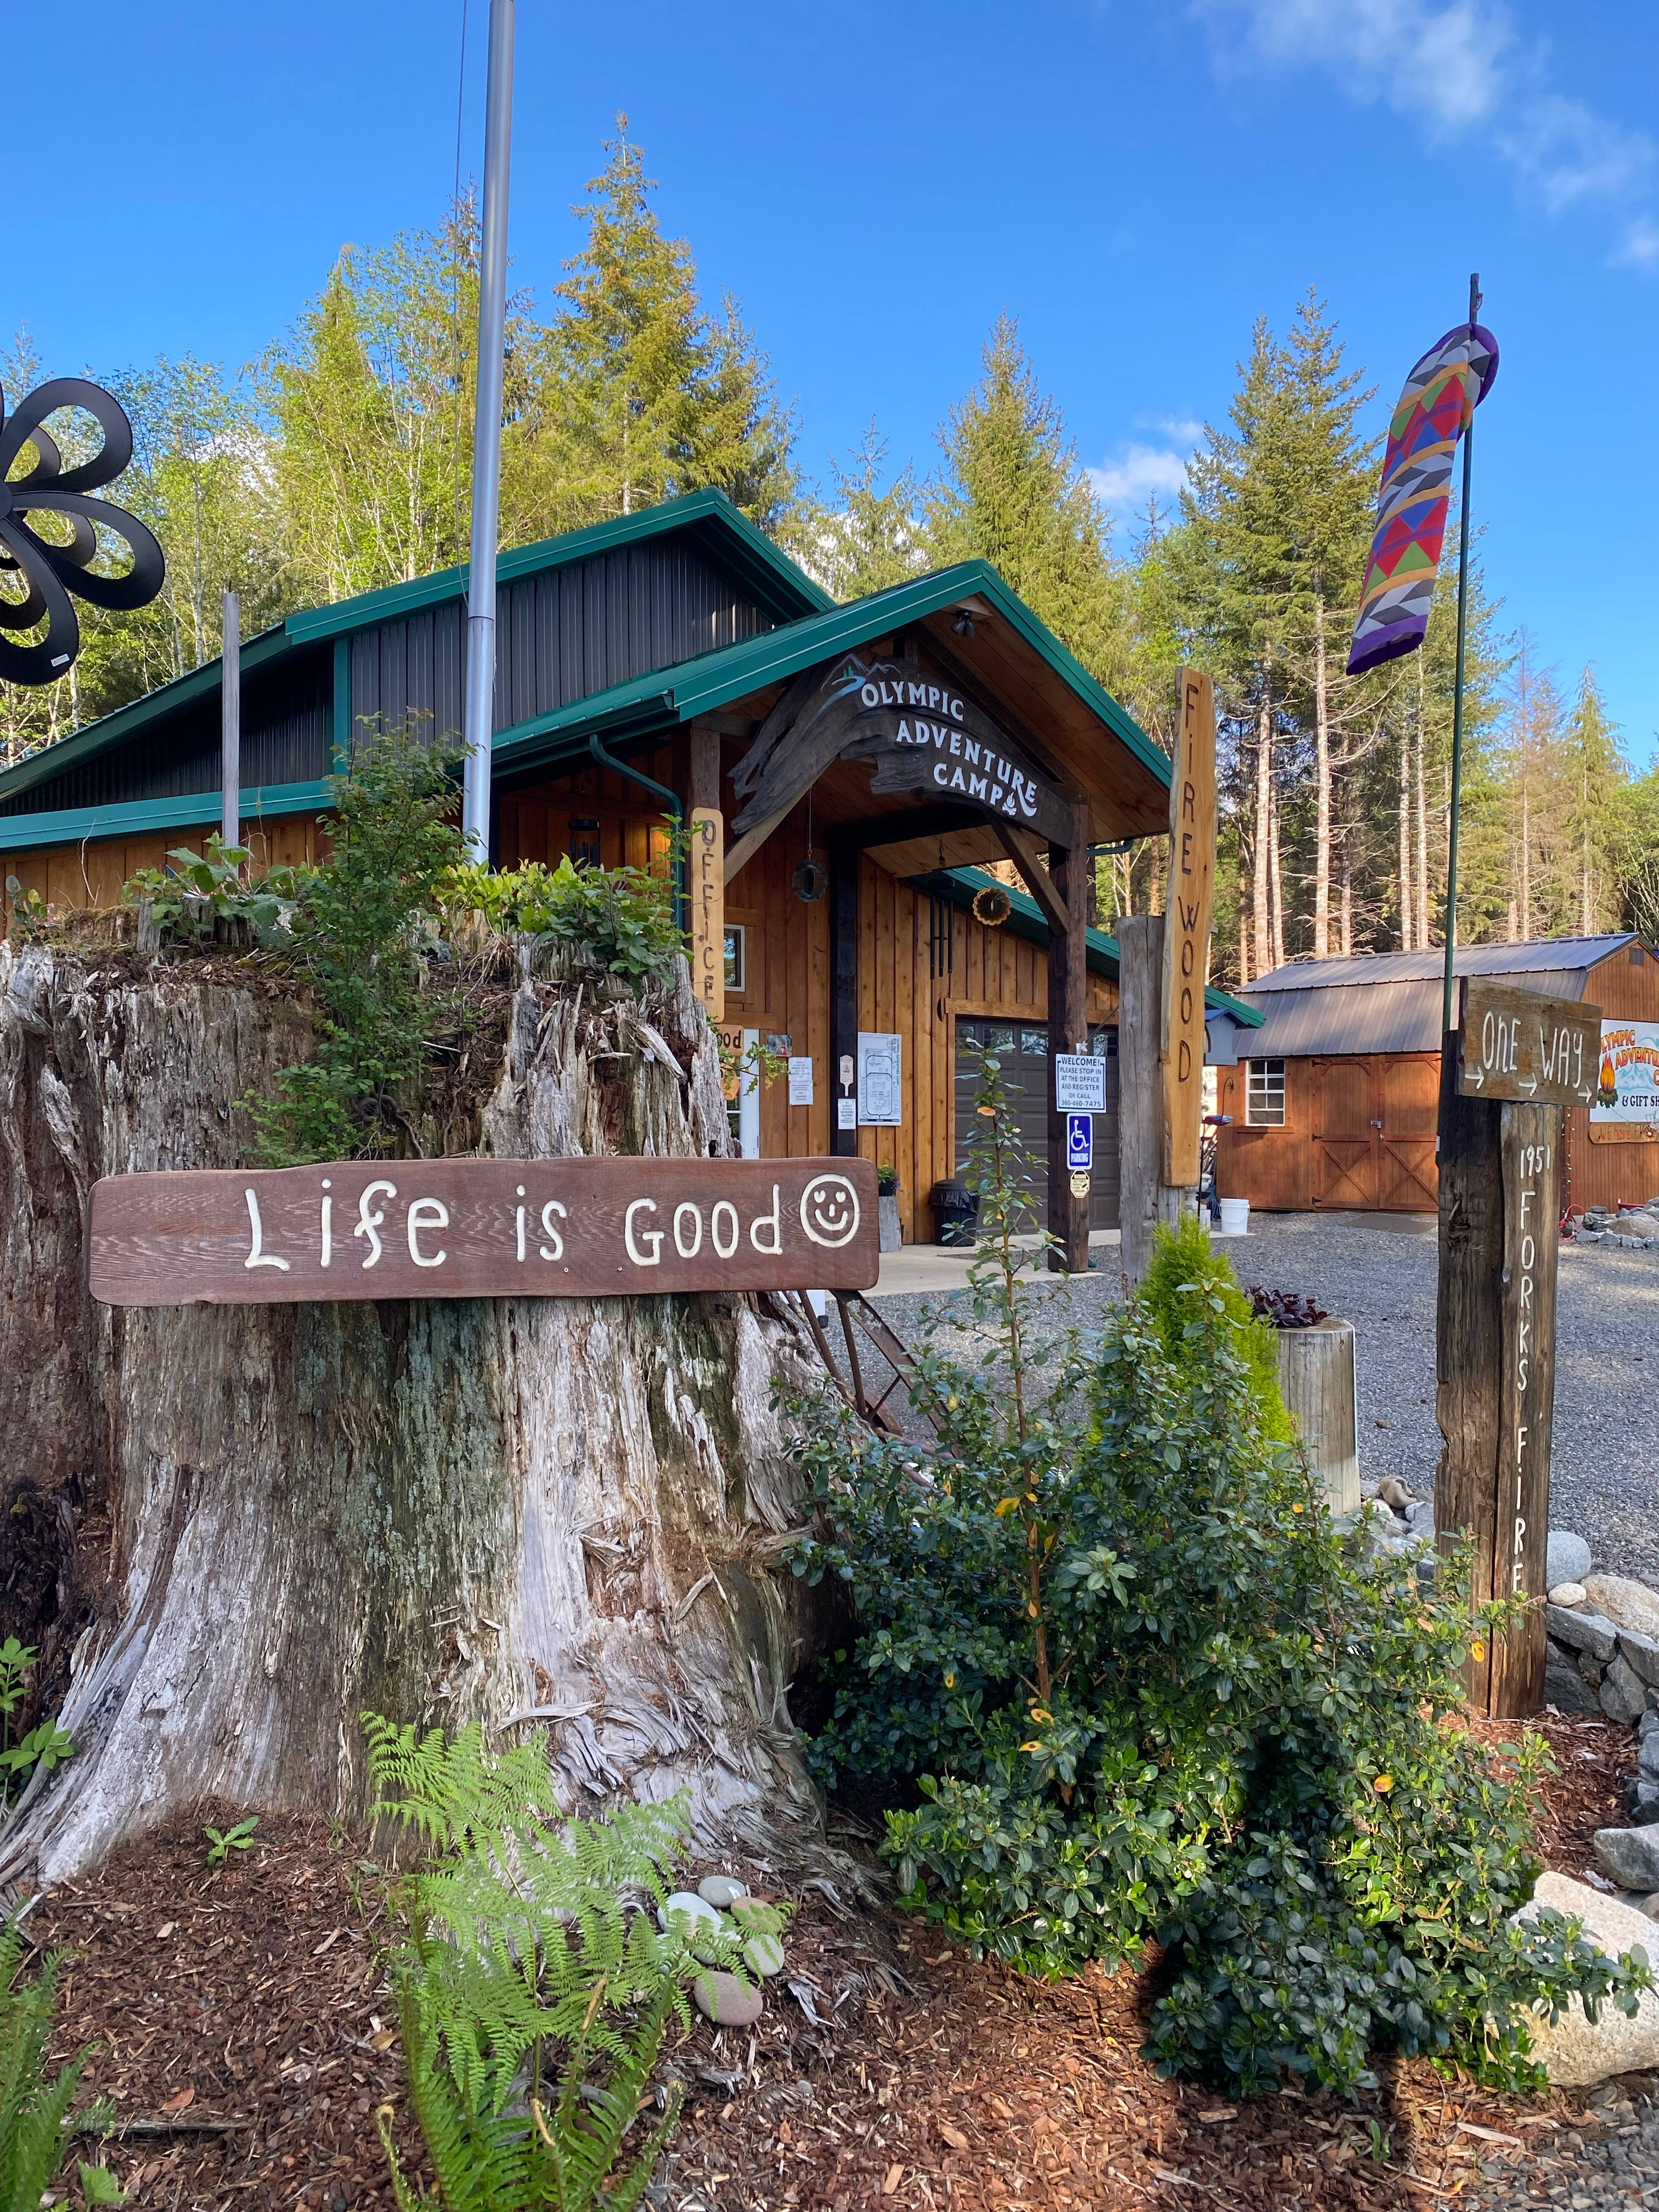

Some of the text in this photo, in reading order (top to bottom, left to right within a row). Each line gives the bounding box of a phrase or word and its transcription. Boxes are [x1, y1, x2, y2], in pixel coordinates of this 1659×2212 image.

[861, 681, 964, 721] OLYMPIC
[896, 720, 1037, 817] ADVENTURE
[934, 763, 1003, 805] CAMP
[716, 1030, 741, 1049] ood
[1601, 1029, 1635, 1054] LYMPIC
[1062, 1057, 1100, 1066] WELCOME!
[1615, 1047, 1659, 1070] ADVENTU
[1622, 1096, 1659, 1107] & GIFT SH
[1071, 1153, 1088, 1163] PARKING
[1520, 1144, 1550, 1179] 1951
[244, 1179, 450, 1271] Life
[516, 1184, 568, 1262] is
[1517, 1190, 1536, 1392] FORKS
